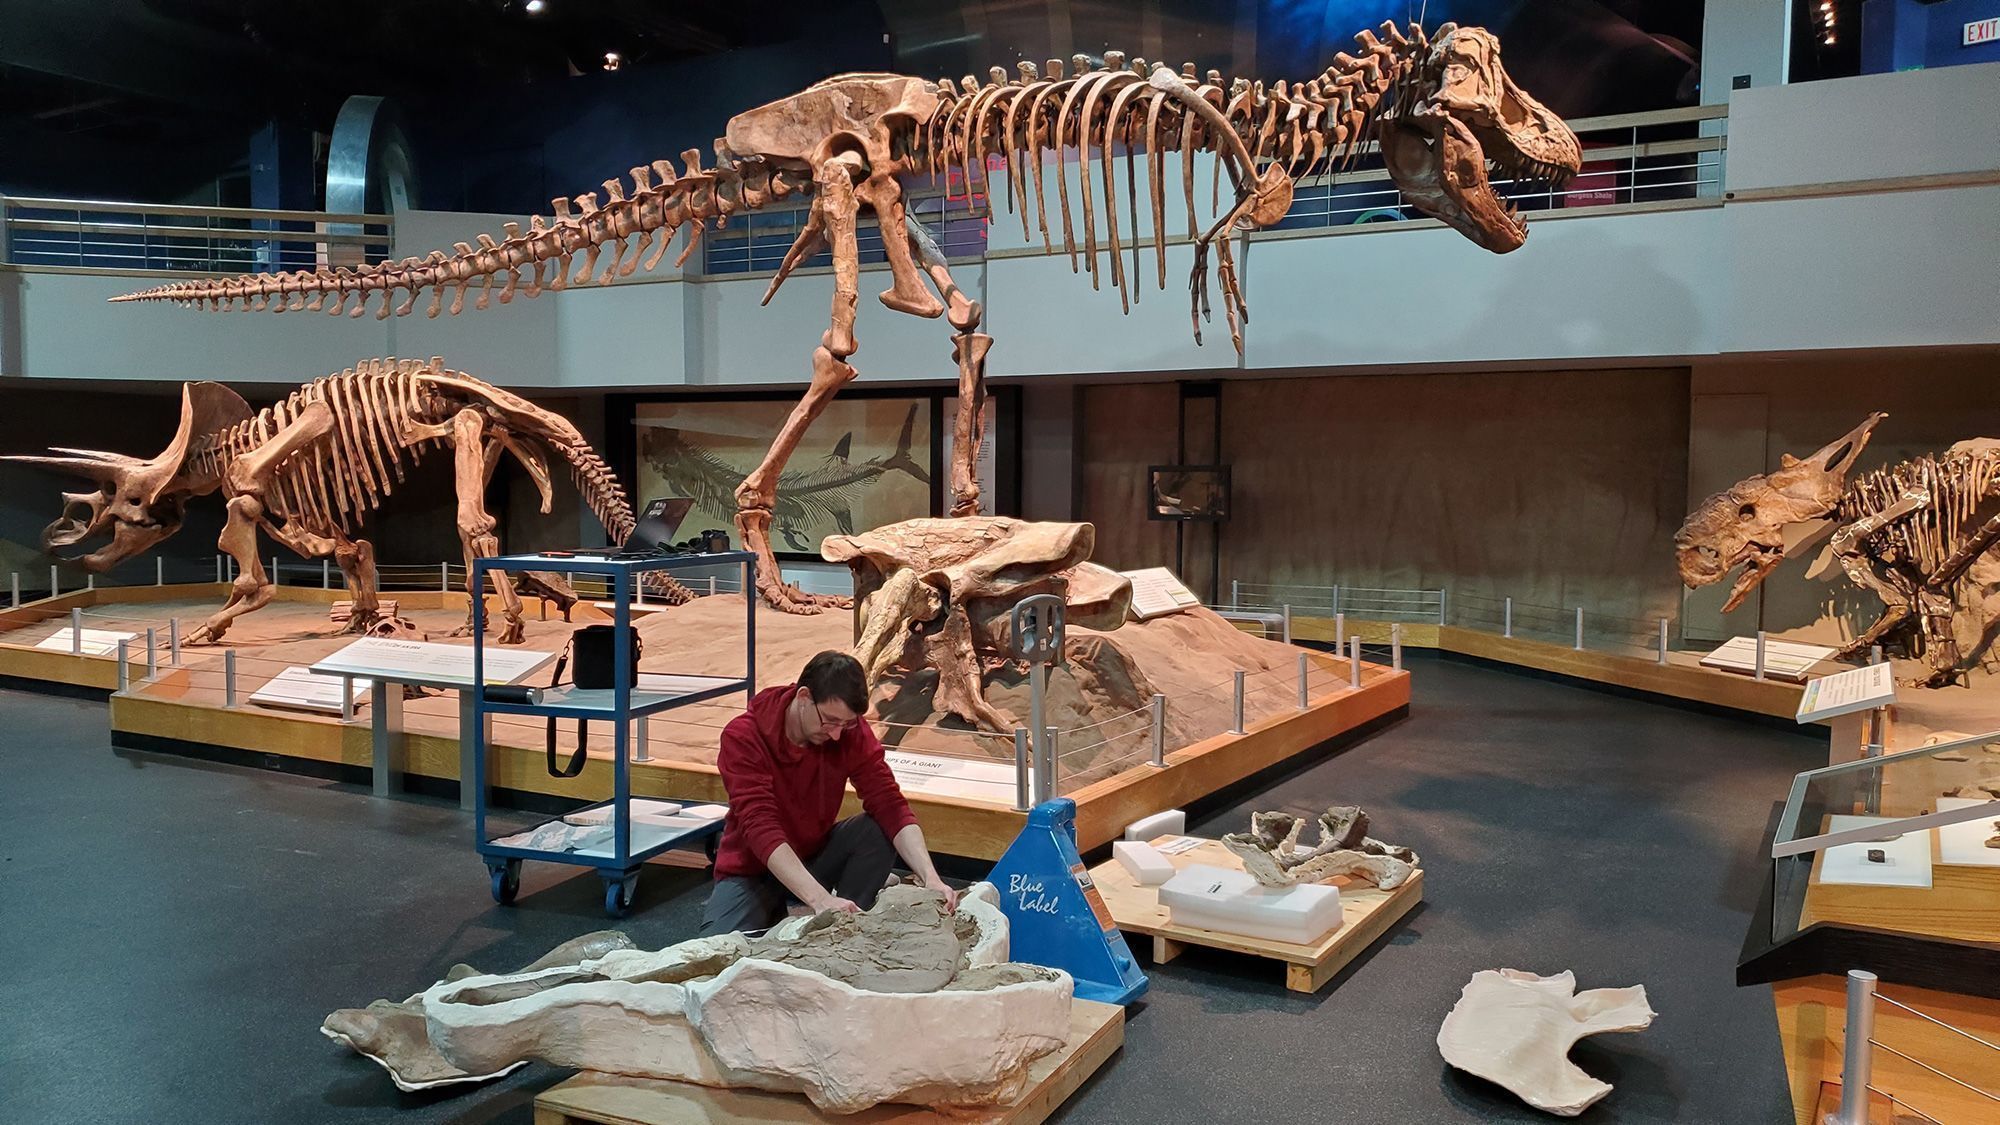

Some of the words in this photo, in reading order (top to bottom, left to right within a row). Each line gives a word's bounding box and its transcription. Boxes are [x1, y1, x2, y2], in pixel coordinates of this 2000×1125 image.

[1968, 20, 1998, 41] EXIT
[918, 761, 943, 769] GIANT
[1009, 874, 1044, 893] Blue
[1019, 891, 1059, 914] Label
